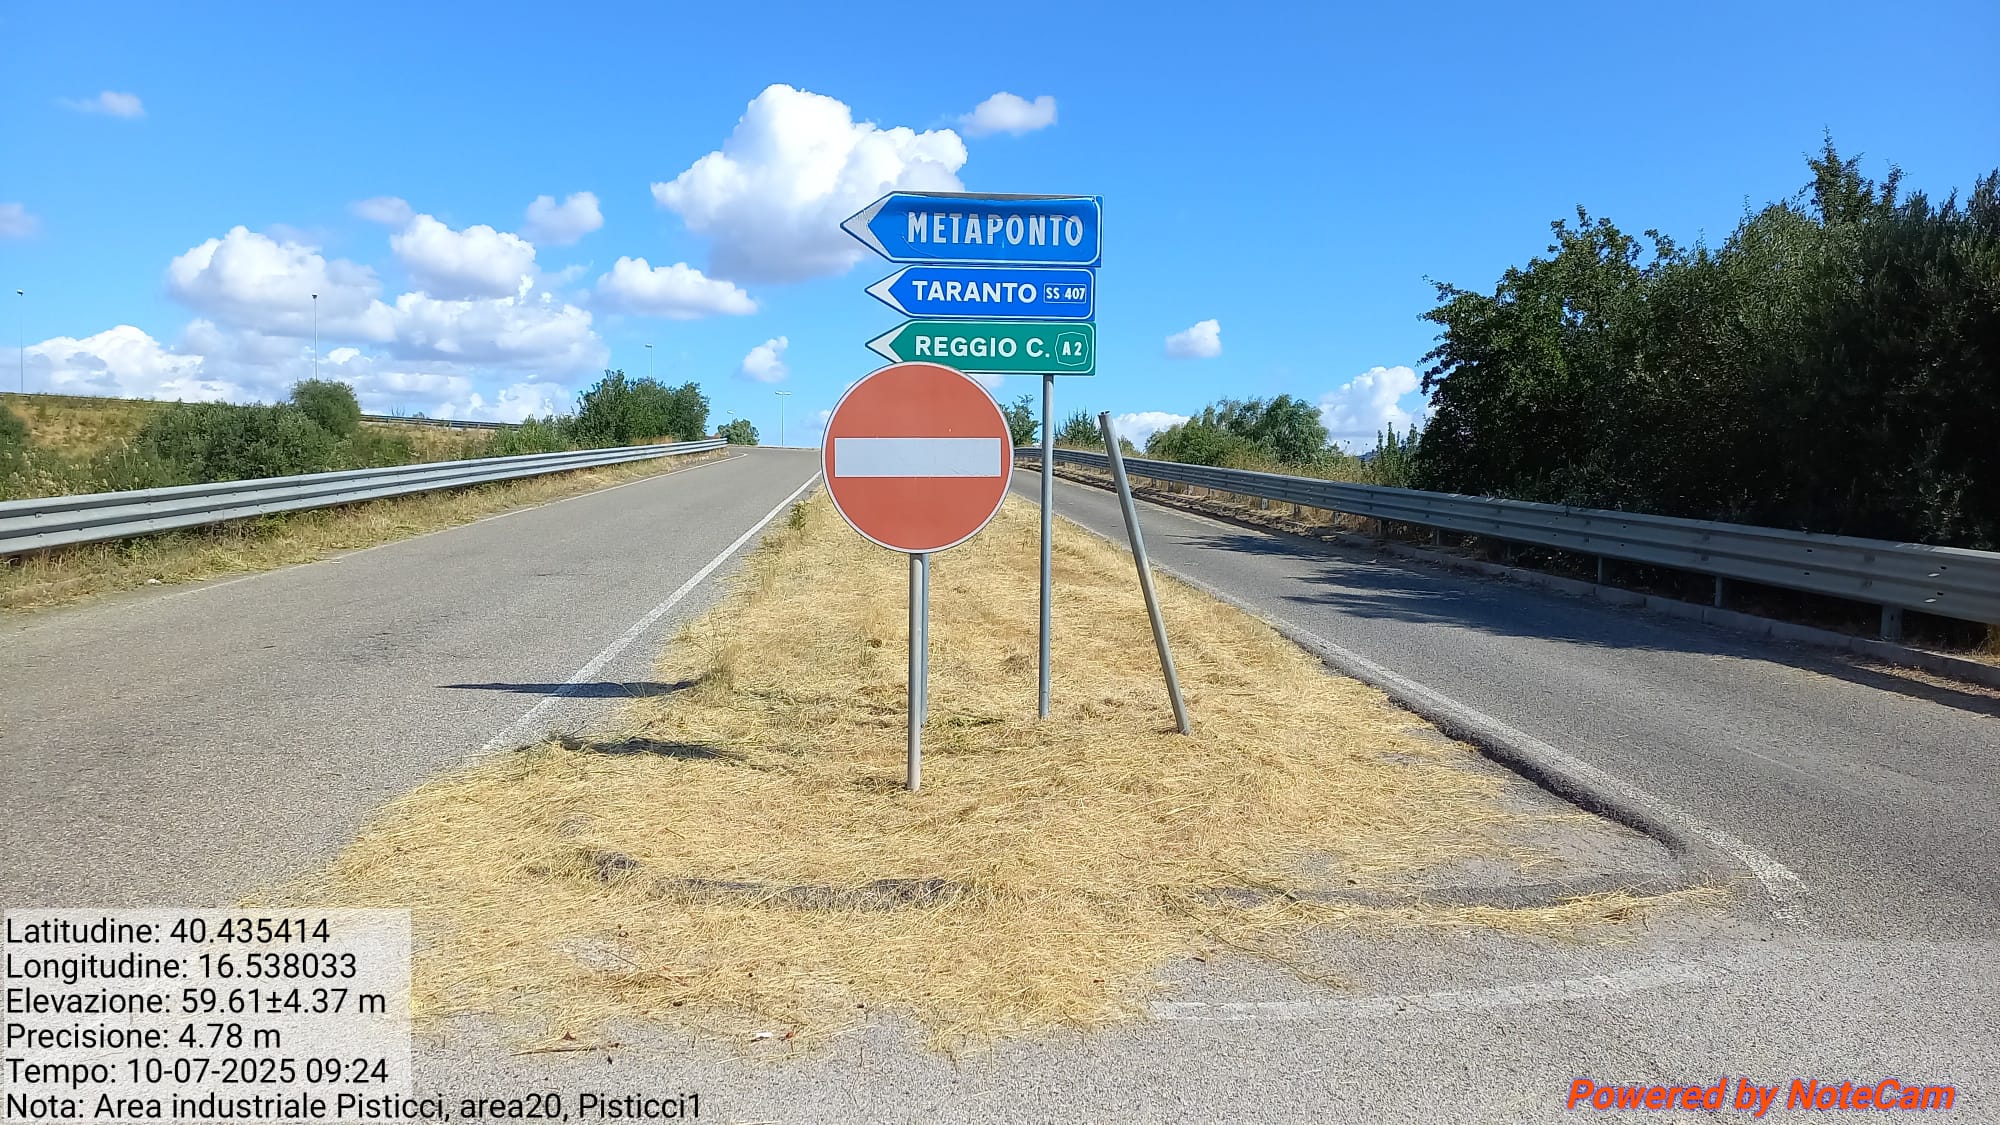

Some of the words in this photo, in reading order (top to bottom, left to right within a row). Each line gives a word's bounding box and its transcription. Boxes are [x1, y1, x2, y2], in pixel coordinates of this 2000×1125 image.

[907, 211, 1084, 247] METAPONTO
[912, 280, 1037, 303] TARANTO
[1046, 287, 1060, 299] SS
[1064, 287, 1086, 300] 407
[915, 335, 1017, 358] REGGIO
[1026, 337, 1050, 358] C.
